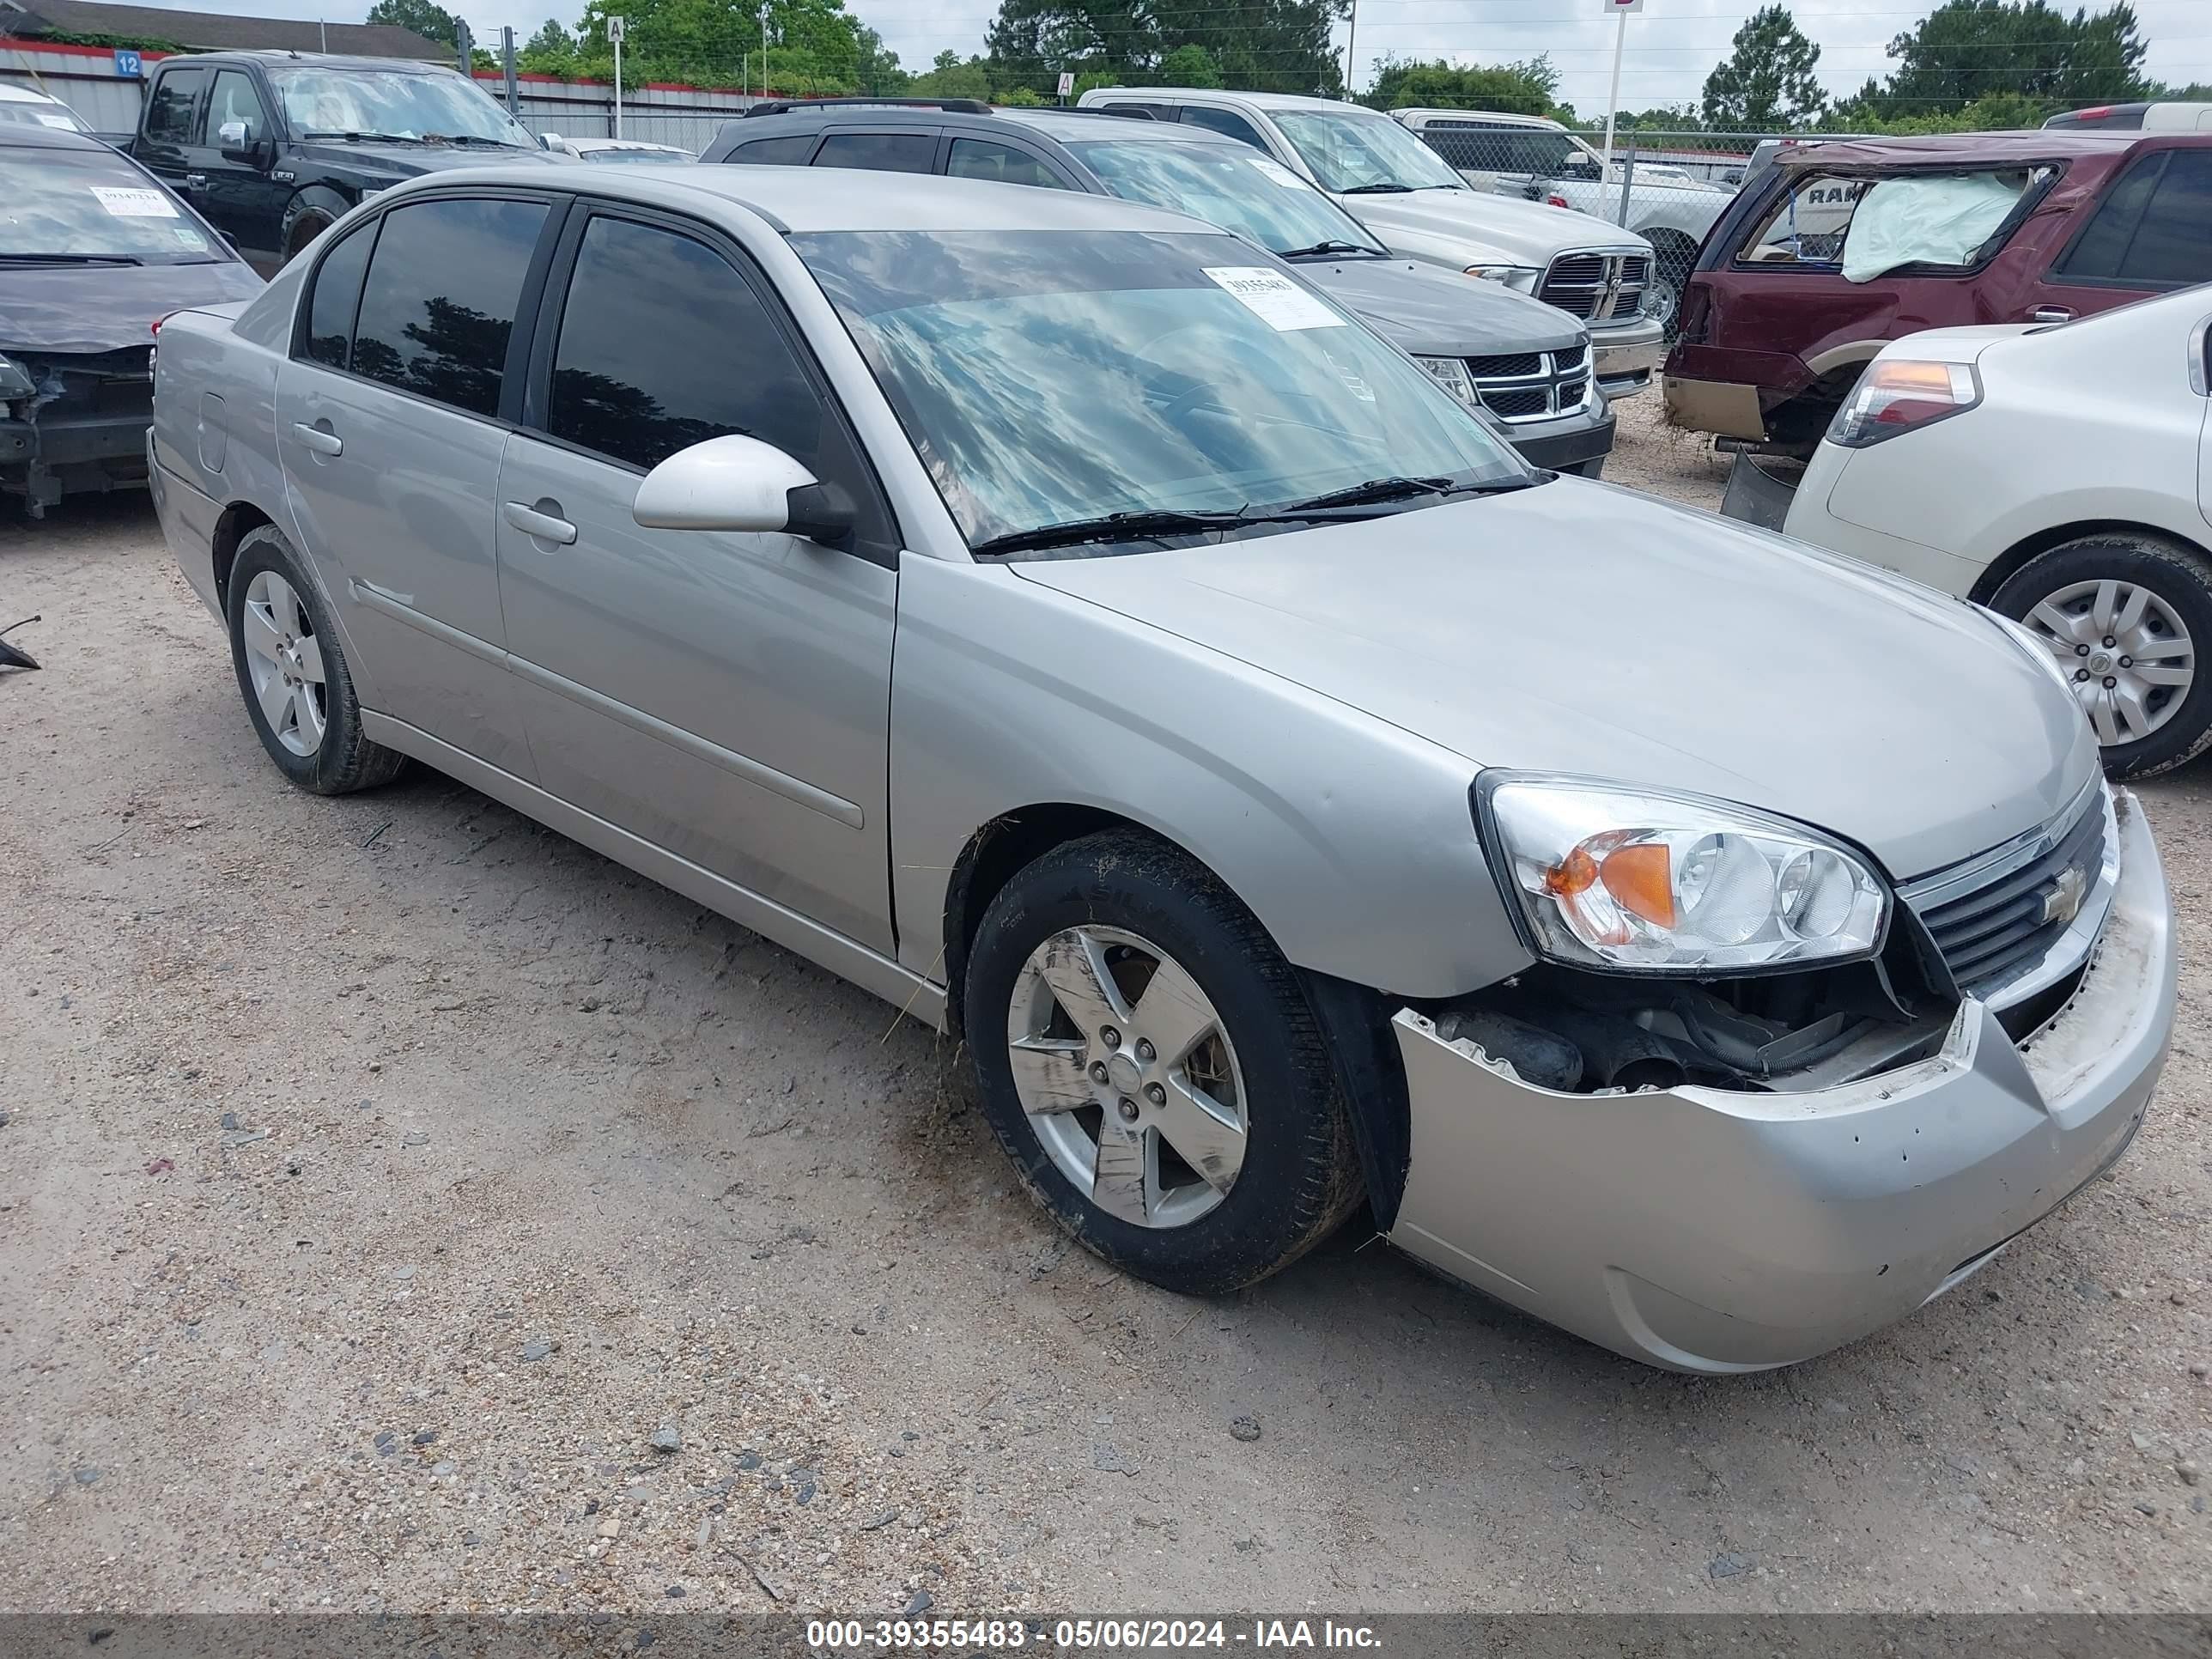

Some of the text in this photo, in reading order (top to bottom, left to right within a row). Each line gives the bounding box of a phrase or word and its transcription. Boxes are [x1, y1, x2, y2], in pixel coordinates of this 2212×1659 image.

[611, 21, 621, 37] A
[119, 56, 138, 73] 12
[1059, 75, 1070, 95] A
[1227, 279, 1292, 292] 39355483
